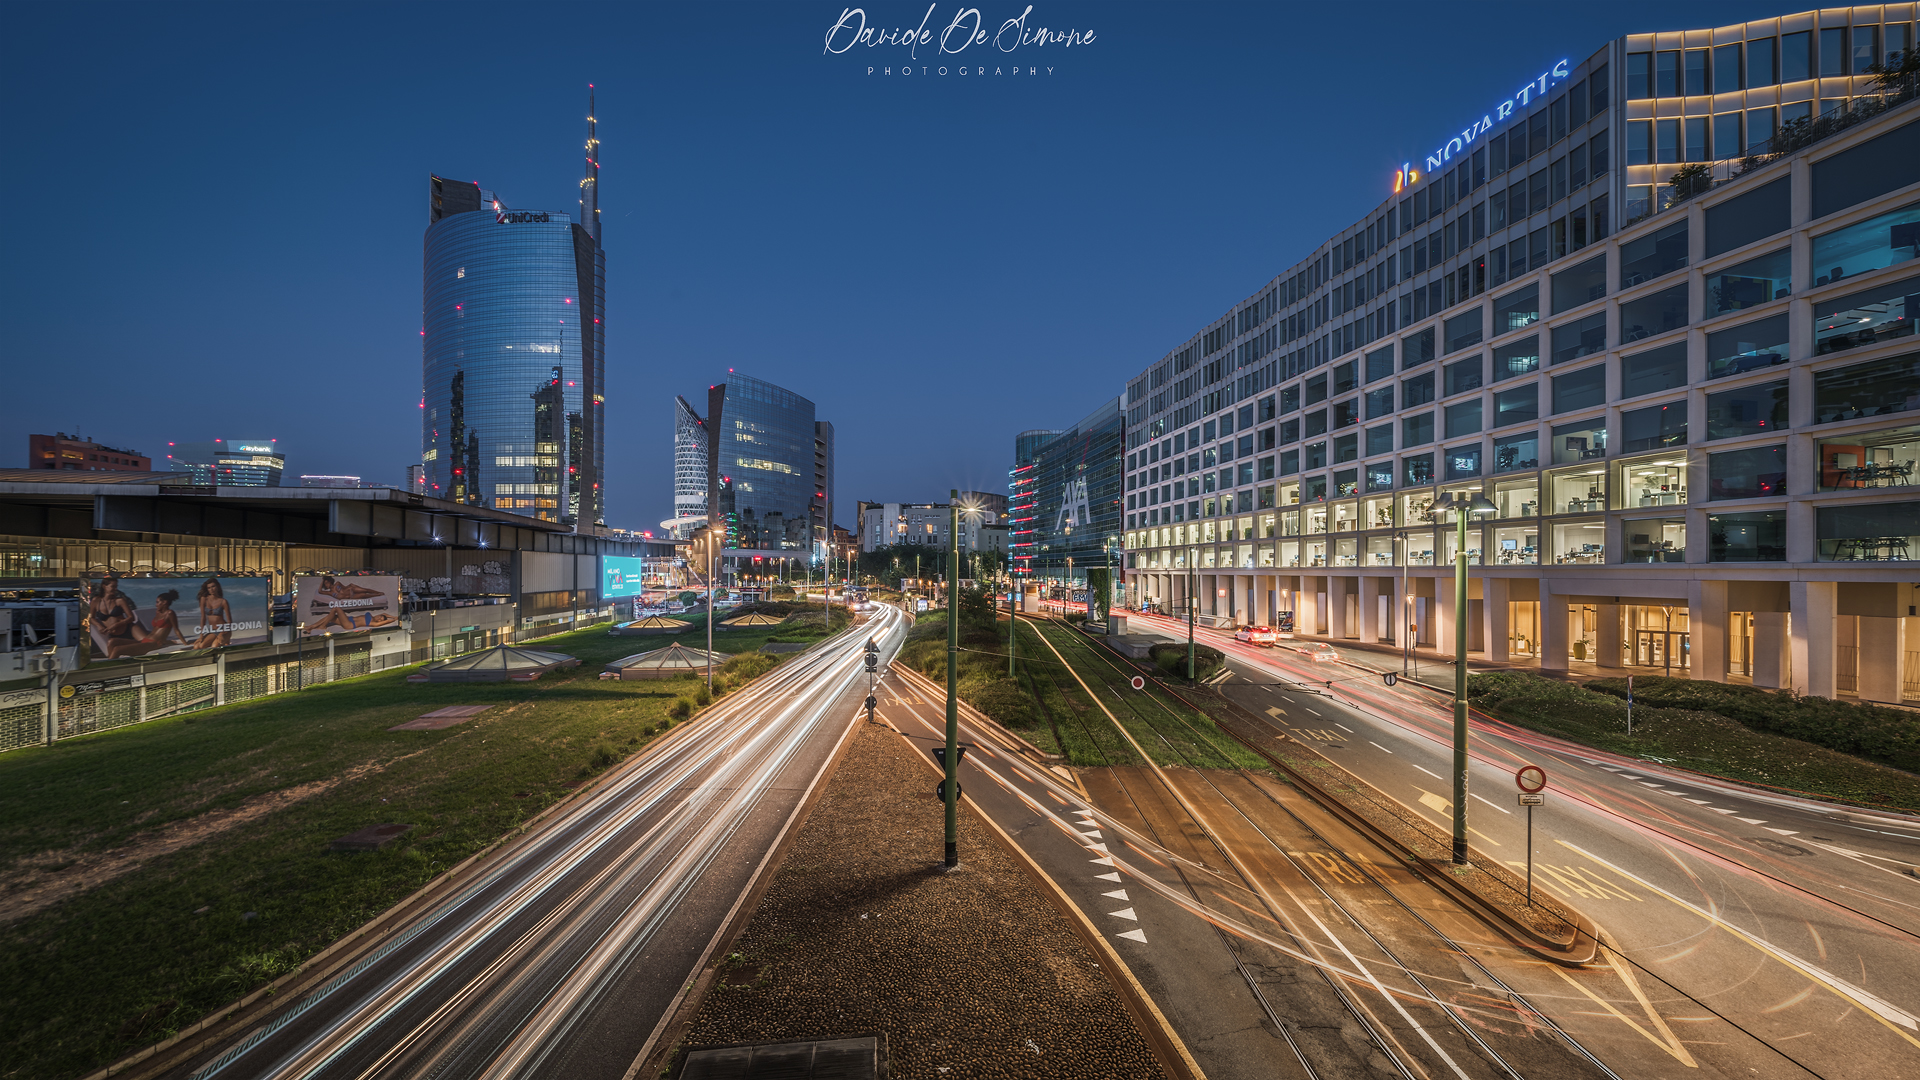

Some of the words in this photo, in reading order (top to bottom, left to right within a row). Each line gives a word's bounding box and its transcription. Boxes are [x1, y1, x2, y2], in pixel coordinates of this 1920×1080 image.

[1426, 59, 1569, 172] NOVARTIS
[1055, 476, 1091, 530] AXA
[329, 599, 374, 608] CALZEDONIA
[193, 620, 263, 634] CALZEDONIA
[1290, 728, 1349, 741] TAXI
[1287, 851, 1399, 884] TRAM
[1505, 860, 1644, 902] TAXI
